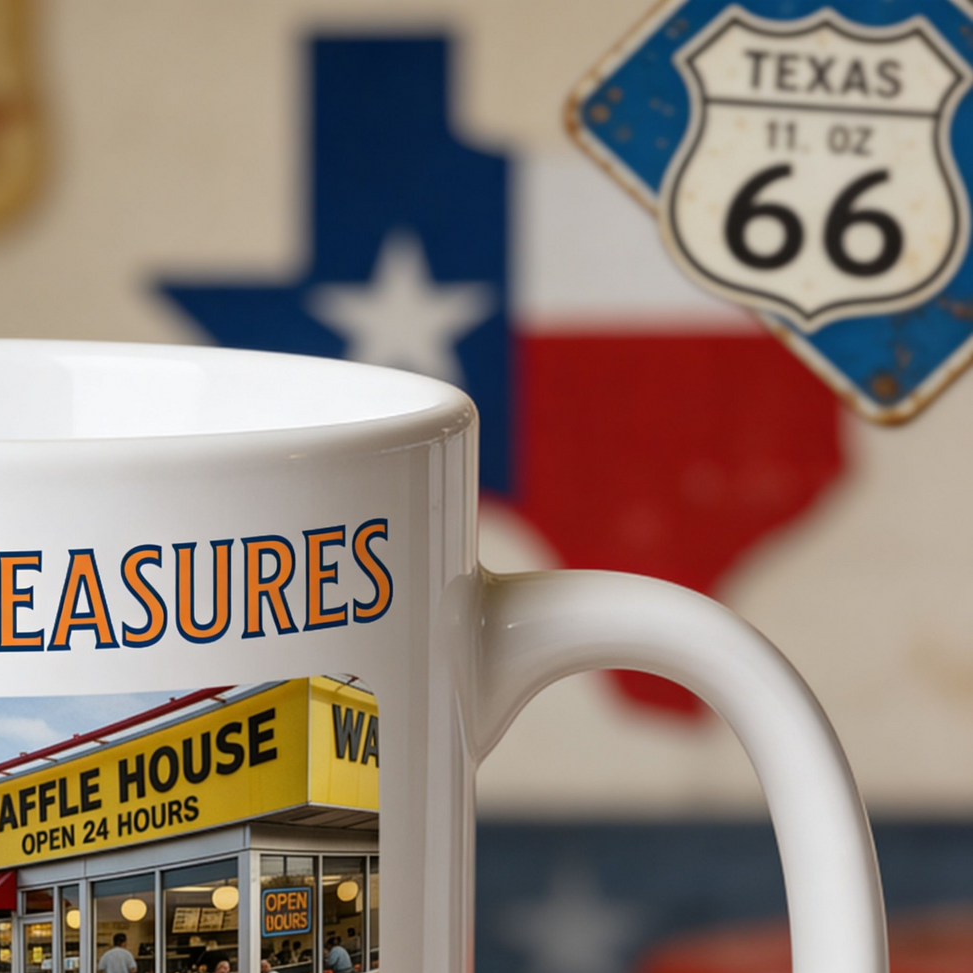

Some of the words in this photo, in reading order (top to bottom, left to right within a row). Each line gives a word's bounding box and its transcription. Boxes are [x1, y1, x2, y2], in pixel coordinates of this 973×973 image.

[741, 49, 904, 100] TEXAS
[827, 124, 876, 157] OZ
[724, 162, 904, 279] 66
[118, 707, 278, 804] HOUSE
[332, 703, 379, 768] WA
[21, 824, 75, 855] OPEN
[83, 817, 109, 844] 24
[117, 795, 199, 837] HOURS
[265, 892, 308, 912] OPEN
